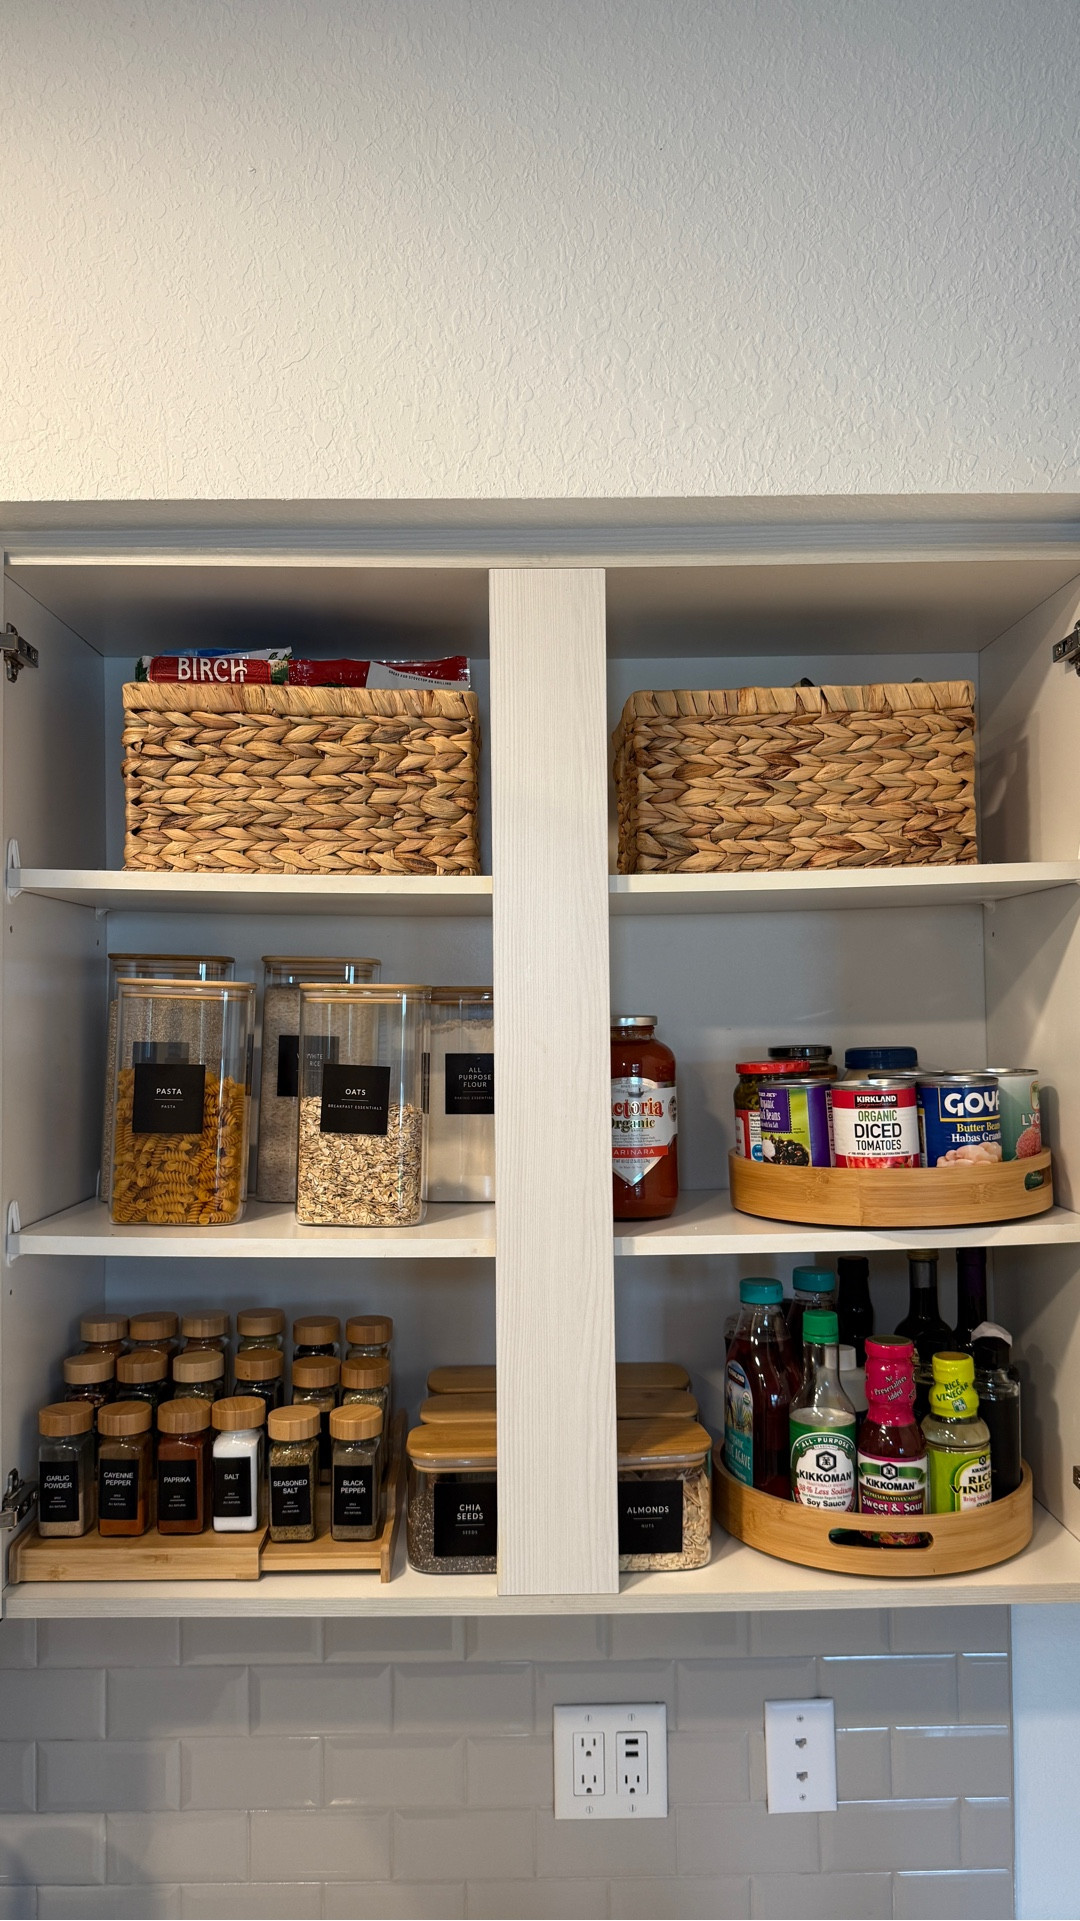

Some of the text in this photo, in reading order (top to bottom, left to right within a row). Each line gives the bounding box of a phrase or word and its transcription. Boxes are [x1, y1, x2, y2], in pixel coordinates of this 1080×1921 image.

[178, 657, 248, 683] BIRCH
[345, 1088, 366, 1096] OATS
[856, 1095, 897, 1103] KIRKLAND
[611, 1098, 664, 1119] ctoria
[857, 1110, 898, 1122] ORGANIC
[854, 1123, 902, 1138] DICED
[957, 1123, 985, 1133] Butter
[951, 1133, 981, 1143] Habas
[856, 1139, 902, 1151] TOMATOES
[613, 1148, 655, 1156] ARINARA
[874, 1376, 907, 1395] Preservatives
[943, 1378, 960, 1392] RICE
[887, 1388, 903, 1401] Added
[935, 1381, 969, 1402] VINEGAR
[799, 1469, 852, 1483] KIKKOMAN
[273, 1479, 308, 1487] SEASONED
[865, 1476, 915, 1491] KIKKOMAN
[951, 1481, 991, 1495] VINEG
[814, 1487, 829, 1495] Less
[459, 1503, 481, 1511] CHIA
[806, 1498, 821, 1507] Soy
[823, 1499, 846, 1508] Sauce
[862, 1496, 888, 1511] Sweet
[891, 1503, 900, 1512] &
[903, 1502, 922, 1512] Sour
[626, 1505, 670, 1514] ALMONDS
[456, 1512, 484, 1520] SEEDS
